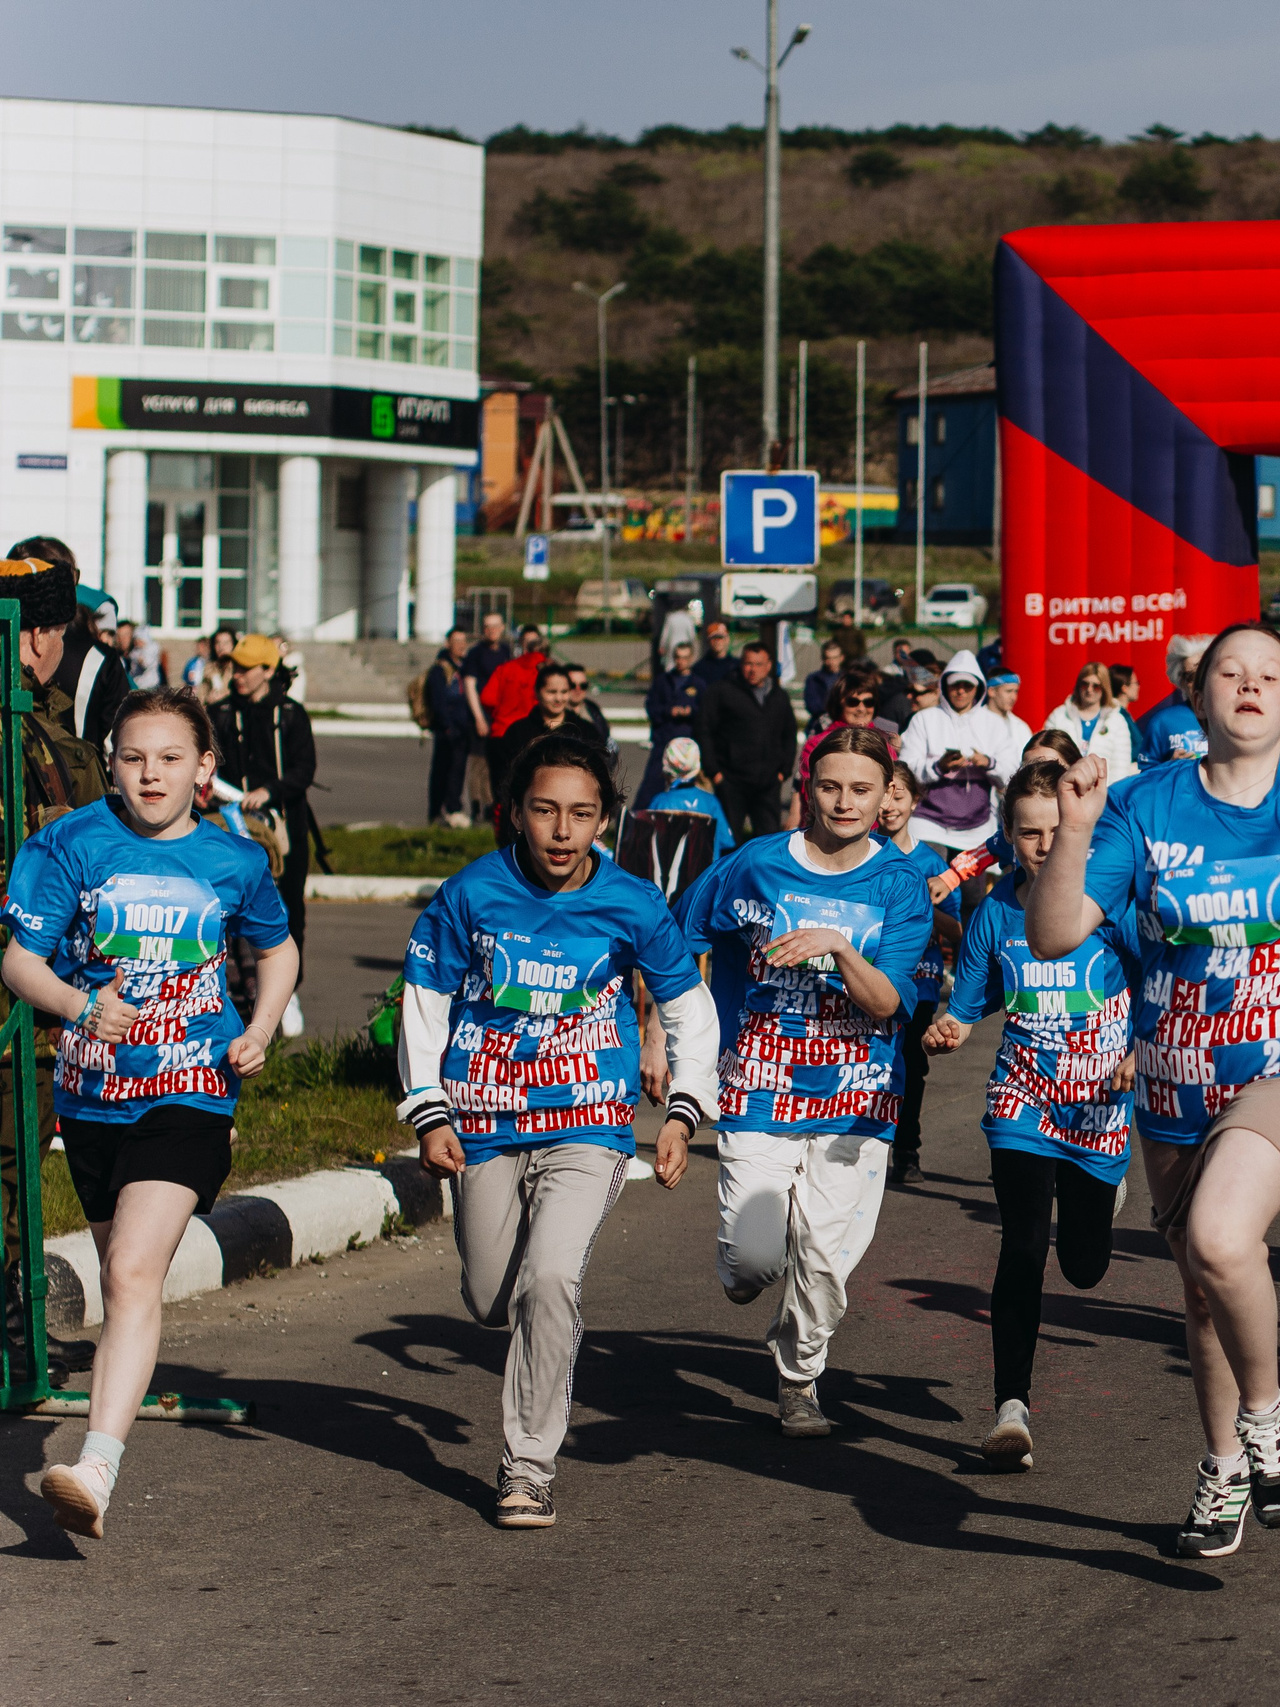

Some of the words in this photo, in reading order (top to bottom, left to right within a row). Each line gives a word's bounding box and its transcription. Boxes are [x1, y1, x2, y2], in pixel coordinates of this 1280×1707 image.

[752, 488, 798, 553] P
[1025, 593, 1044, 616] В
[1049, 596, 1126, 618] ритме
[1131, 588, 1187, 612] всей
[1048, 618, 1164, 645] СТРАНЫ!
[1175, 868, 1194, 878] ПСБ
[8, 902, 43, 931] ПСБ
[124, 903, 189, 934] 10017
[1186, 888, 1259, 924] 10041
[406, 937, 437, 964] ПСБ
[514, 934, 531, 943] ПСБ
[517, 958, 578, 990] 10013
[1021, 961, 1076, 988] 10015
[157, 1038, 213, 1073] 2024
[468, 1052, 599, 1087] #ГОРДОСТЬ
[571, 1078, 627, 1108] 2024
